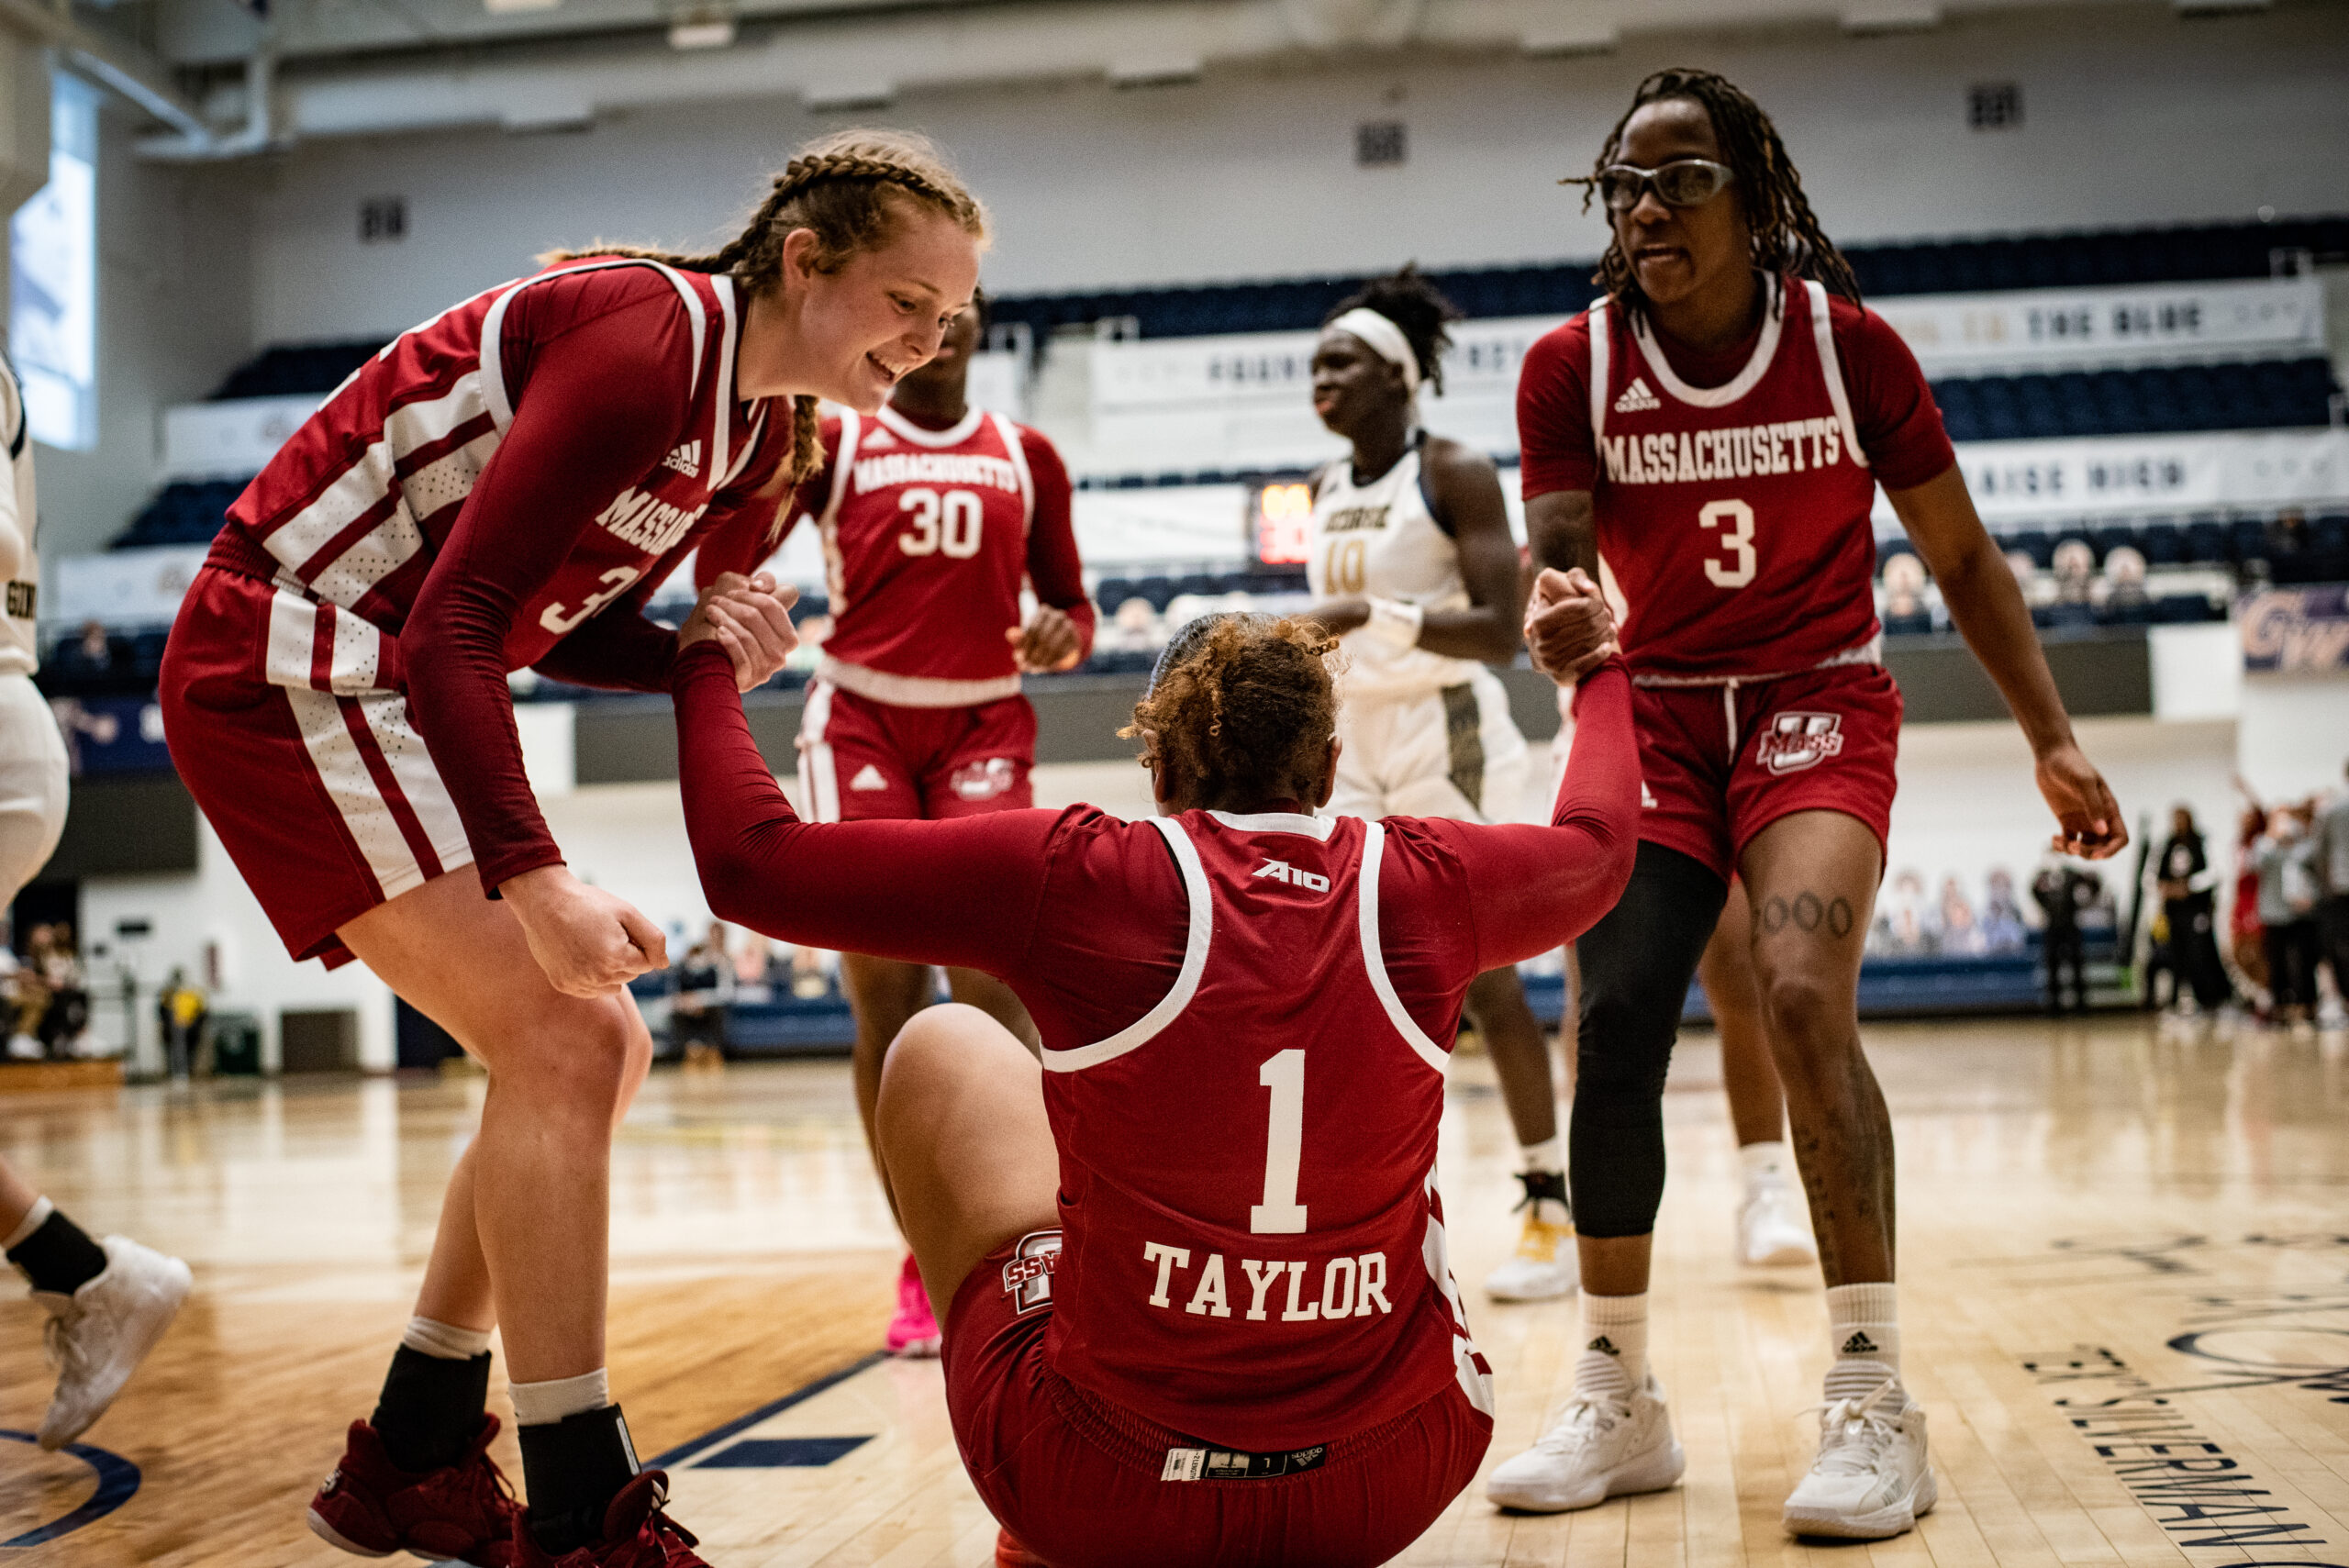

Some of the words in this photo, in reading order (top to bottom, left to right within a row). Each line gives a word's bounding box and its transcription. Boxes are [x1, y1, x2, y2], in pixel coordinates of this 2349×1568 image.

[1602, 416, 1841, 484] MASSACHUSETTS
[898, 487, 984, 559] 30
[1698, 499, 1757, 589] 3
[1252, 857, 1330, 894] A10
[1251, 1049, 1308, 1233] 1
[1143, 1241, 1392, 1321] TAYLOR
[2054, 1392, 2329, 1547] SILVERMAN
